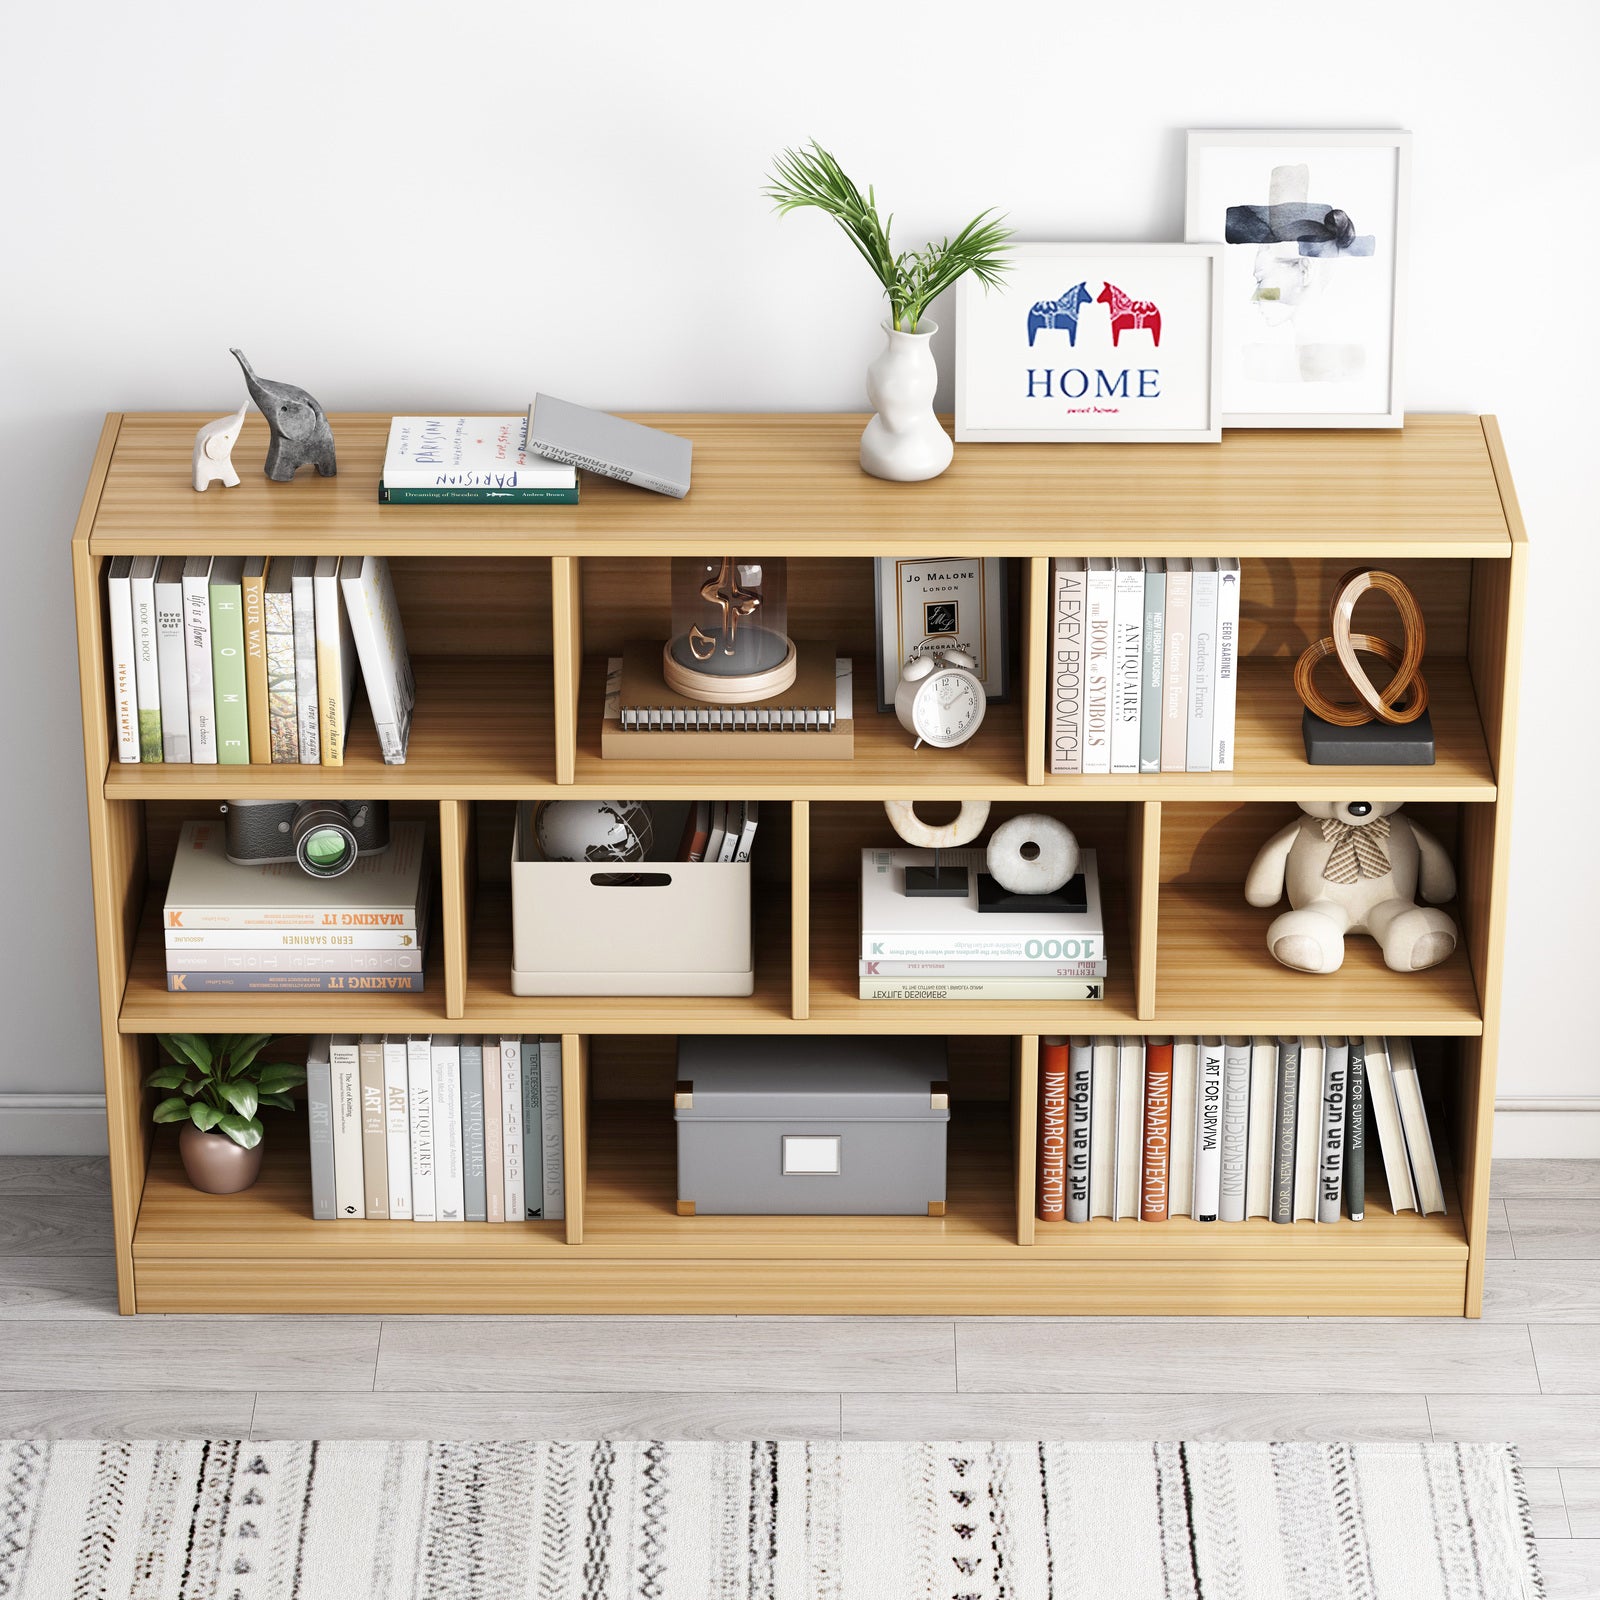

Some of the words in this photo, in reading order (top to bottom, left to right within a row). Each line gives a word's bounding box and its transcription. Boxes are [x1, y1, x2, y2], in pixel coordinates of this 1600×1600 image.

[1026, 369, 1160, 398] HOME
[413, 420, 446, 463] PARISIAN
[533, 442, 607, 468] PRIMZAHLEN
[538, 451, 608, 477] EINSAMKEIT
[436, 471, 518, 488] PARISIAN
[610, 466, 633, 476] DER
[611, 473, 629, 482] DIE
[928, 572, 974, 580] MALONE
[187, 595, 206, 608] life
[246, 585, 260, 625] YOUR
[1059, 578, 1081, 645] ALEXEY
[1092, 603, 1100, 616] THE
[1153, 613, 1162, 629] NEW
[1222, 622, 1232, 640] EERO
[188, 623, 206, 648] flower
[248, 629, 262, 658] WAY
[1090, 620, 1108, 660] BOOK
[1152, 630, 1161, 654] URBAN
[1169, 632, 1184, 671] Gardens
[1196, 633, 1210, 671] Gardens
[1220, 643, 1231, 678] SAARINEN
[1122, 624, 1140, 722] ANTIQUAIRES
[1152, 655, 1160, 687] HOUSING
[1170, 675, 1182, 683] in
[1196, 675, 1208, 683] in
[308, 705, 318, 720] love
[327, 697, 338, 726] stronger
[969, 698, 973, 706] 3
[1056, 651, 1079, 761] BRODOVITCH
[1089, 676, 1106, 746] SYMBOLS
[1169, 687, 1182, 719] France
[1195, 687, 1208, 718] France
[307, 732, 318, 756] prague
[330, 729, 339, 745] than
[330, 747, 338, 759] sin
[322, 914, 337, 925] IT
[343, 914, 403, 925] MAKING
[282, 936, 327, 944] SAARINEN
[332, 936, 353, 944] EERO
[1025, 939, 1095, 959] 1000
[328, 977, 344, 988] IT
[348, 977, 412, 988] MAKING
[447, 1062, 455, 1076] Detail
[505, 1048, 516, 1090] Over
[530, 1054, 539, 1076] TEXTILE
[1204, 1057, 1219, 1076] ART
[1352, 1057, 1362, 1077] ART
[364, 1086, 381, 1114] ART
[389, 1086, 405, 1113] ART
[446, 1084, 456, 1119] Contemporary
[531, 1077, 539, 1108] DESIGNERS
[1069, 1070, 1090, 1122] urban
[1204, 1080, 1219, 1101] FOR
[1282, 1054, 1296, 1124] REVOLUTION
[1324, 1070, 1344, 1122] urban
[1352, 1080, 1362, 1101] FOR
[312, 1102, 327, 1126] ART
[545, 1086, 559, 1120] BOOK
[415, 1087, 431, 1176] ANTIQUAIRES
[506, 1104, 517, 1133] the
[1203, 1104, 1218, 1150] SURVIVAL
[1222, 1057, 1248, 1196] INNENARCHITEKTUR
[1352, 1104, 1361, 1150] SURVIVAL
[468, 1091, 483, 1177] ANTIQUAIRES
[1043, 1071, 1065, 1212] INNENARCHITEKTUR
[1074, 1128, 1088, 1149] an
[1145, 1071, 1168, 1212] INNENARCHITEKTUR
[1281, 1127, 1294, 1157] LOOK
[1328, 1128, 1342, 1149] an
[449, 1149, 457, 1178] Architecture
[546, 1134, 560, 1195] SYMBOLS
[1068, 1155, 1088, 1173] in
[1280, 1160, 1293, 1184] NEW
[1321, 1155, 1342, 1173] in
[1070, 1176, 1087, 1201] art
[1279, 1187, 1291, 1216] DIOR.
[1323, 1177, 1340, 1201] art
